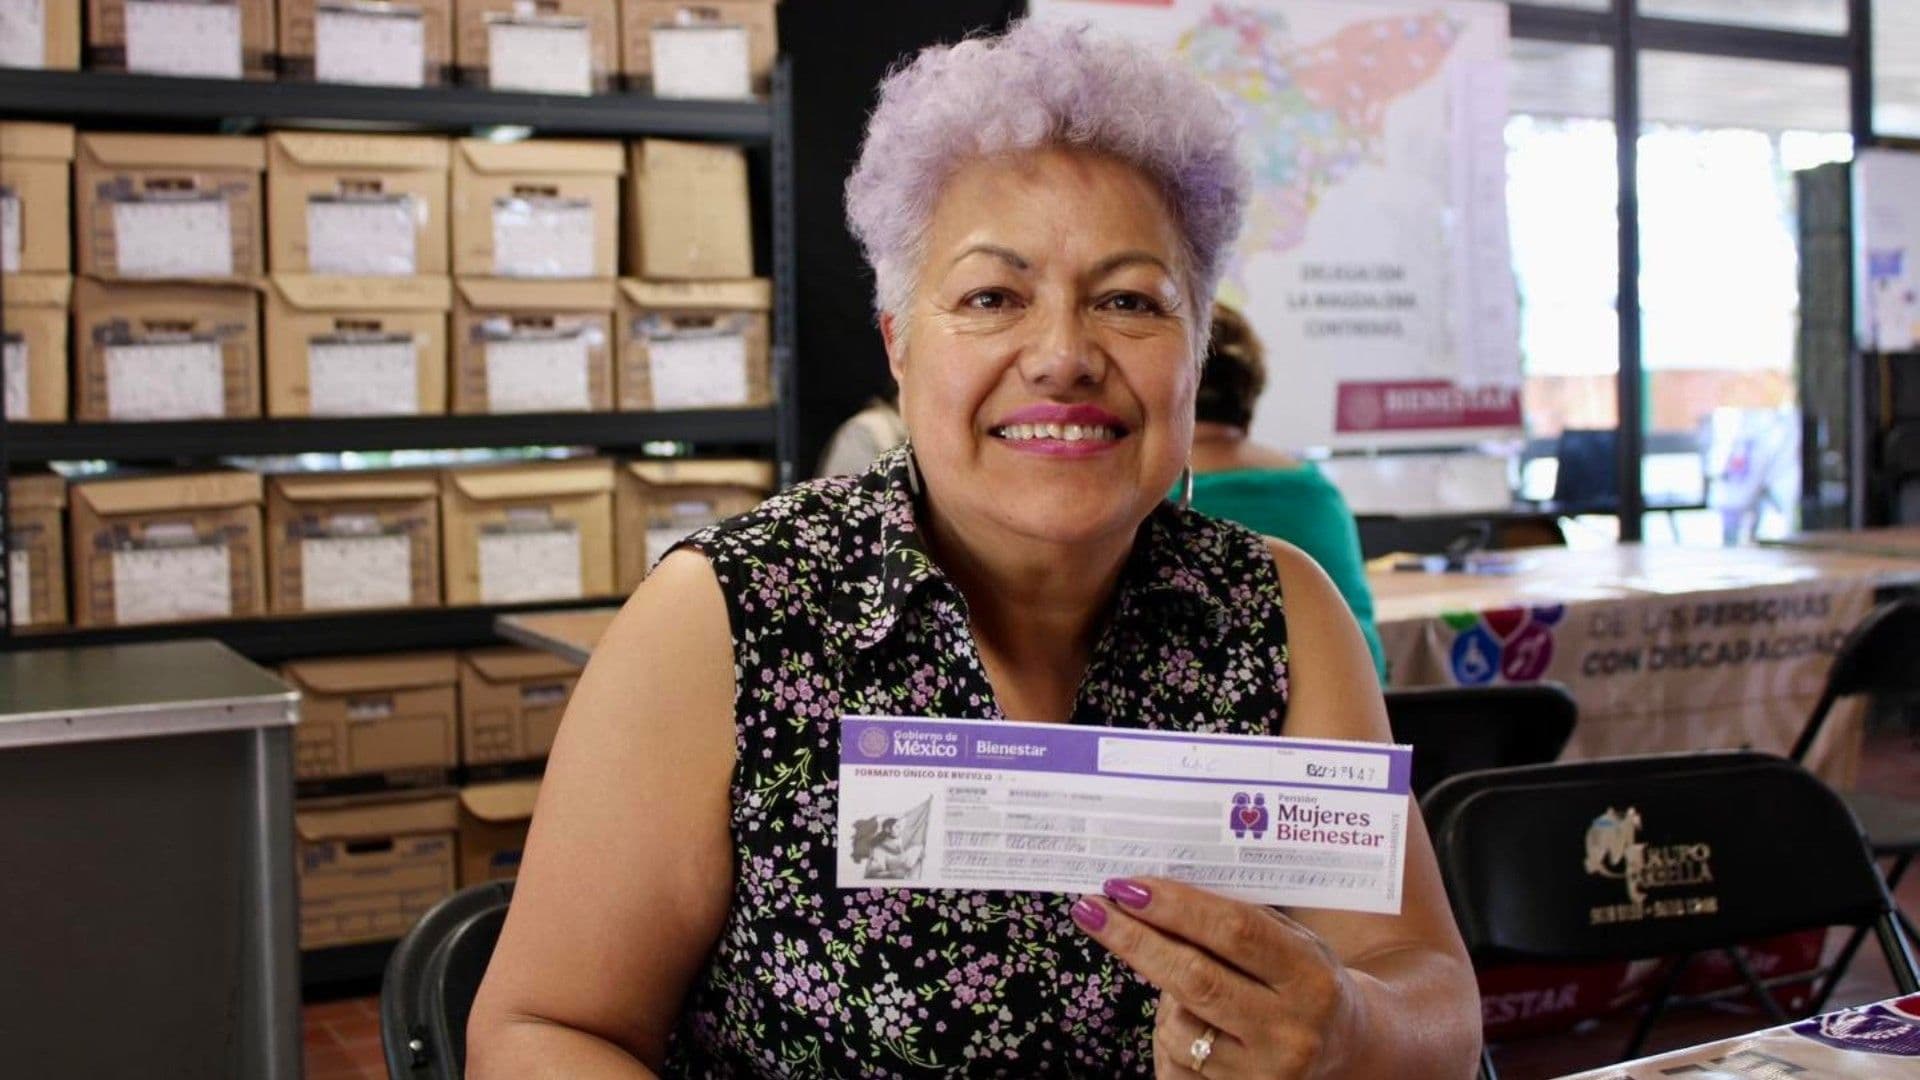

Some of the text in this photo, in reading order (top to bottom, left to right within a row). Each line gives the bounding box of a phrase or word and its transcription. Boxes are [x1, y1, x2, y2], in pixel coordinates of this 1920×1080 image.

[1583, 650, 1640, 677] CON
[893, 729, 958, 742] Gobierno de
[893, 739, 958, 757] México
[976, 739, 1047, 757] Bienestar
[854, 768, 901, 778] FORMATO
[903, 768, 935, 779] ÚNICO
[937, 770, 949, 779] DE
[1278, 803, 1371, 828] Mujeres
[1277, 823, 1385, 847] Bienestar
[1481, 983, 1580, 1024] ESTAR
